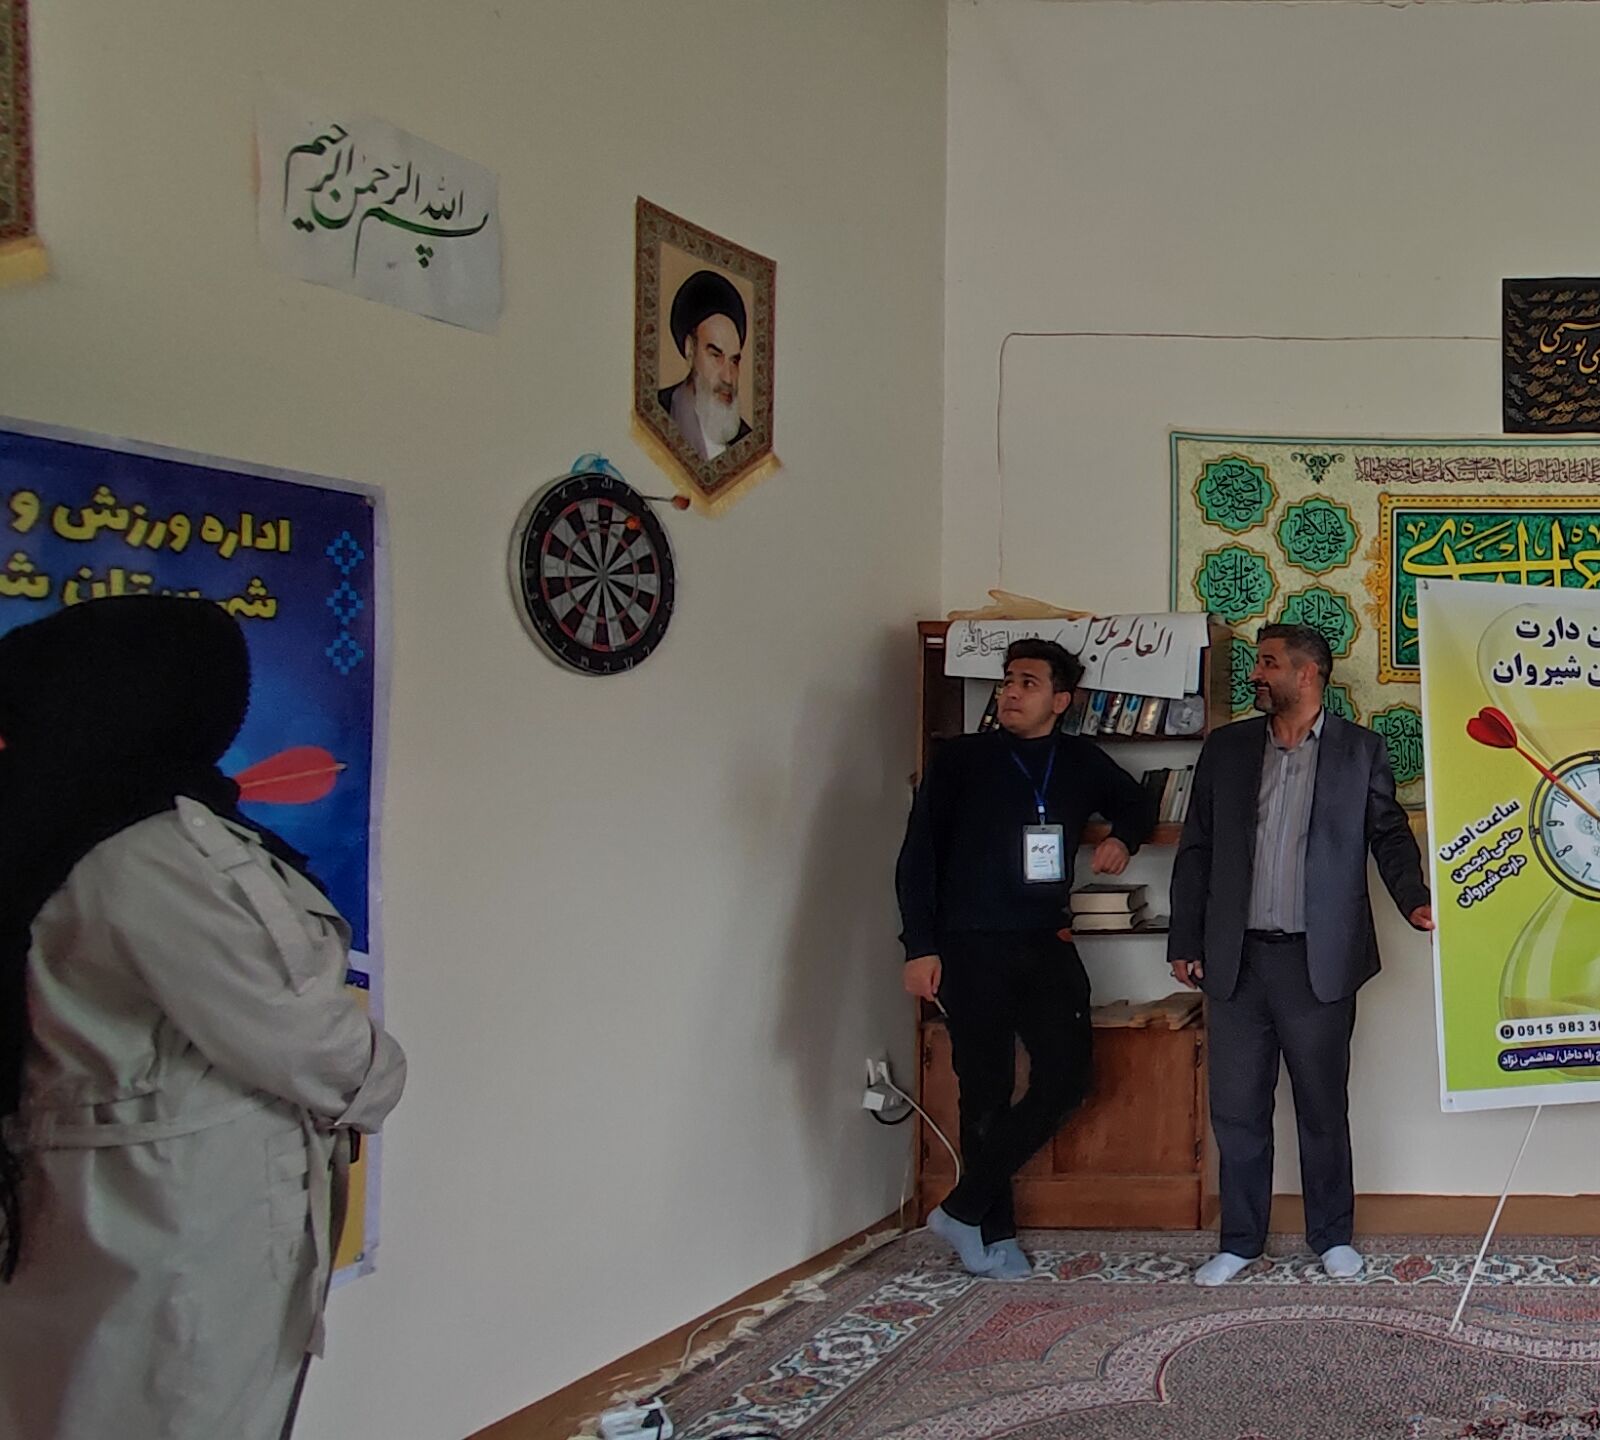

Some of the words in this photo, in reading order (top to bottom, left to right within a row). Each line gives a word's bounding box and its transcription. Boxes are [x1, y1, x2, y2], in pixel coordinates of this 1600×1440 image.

[419, 176, 464, 221] الله
[9, 490, 41, 533] و
[53, 485, 192, 552] ورزش
[203, 511, 291, 559] اداره
[1516, 617, 1580, 647] دارت
[1493, 653, 1582, 686] شیروان
[1569, 773, 1587, 790] 11
[1552, 791, 1571, 808] 10
[1475, 801, 1520, 834] ساعت
[1546, 820, 1564, 828] 9
[1440, 826, 1476, 861] امین
[1490, 828, 1522, 859] حامی
[1556, 845, 1572, 858] 8
[1452, 846, 1491, 883] انجمن
[1499, 855, 1527, 876] دارت
[1580, 863, 1591, 879] 7
[1457, 869, 1501, 907] شیروان
[1517, 1023, 1553, 1036] 0915
[1559, 1020, 1585, 1033] 983
